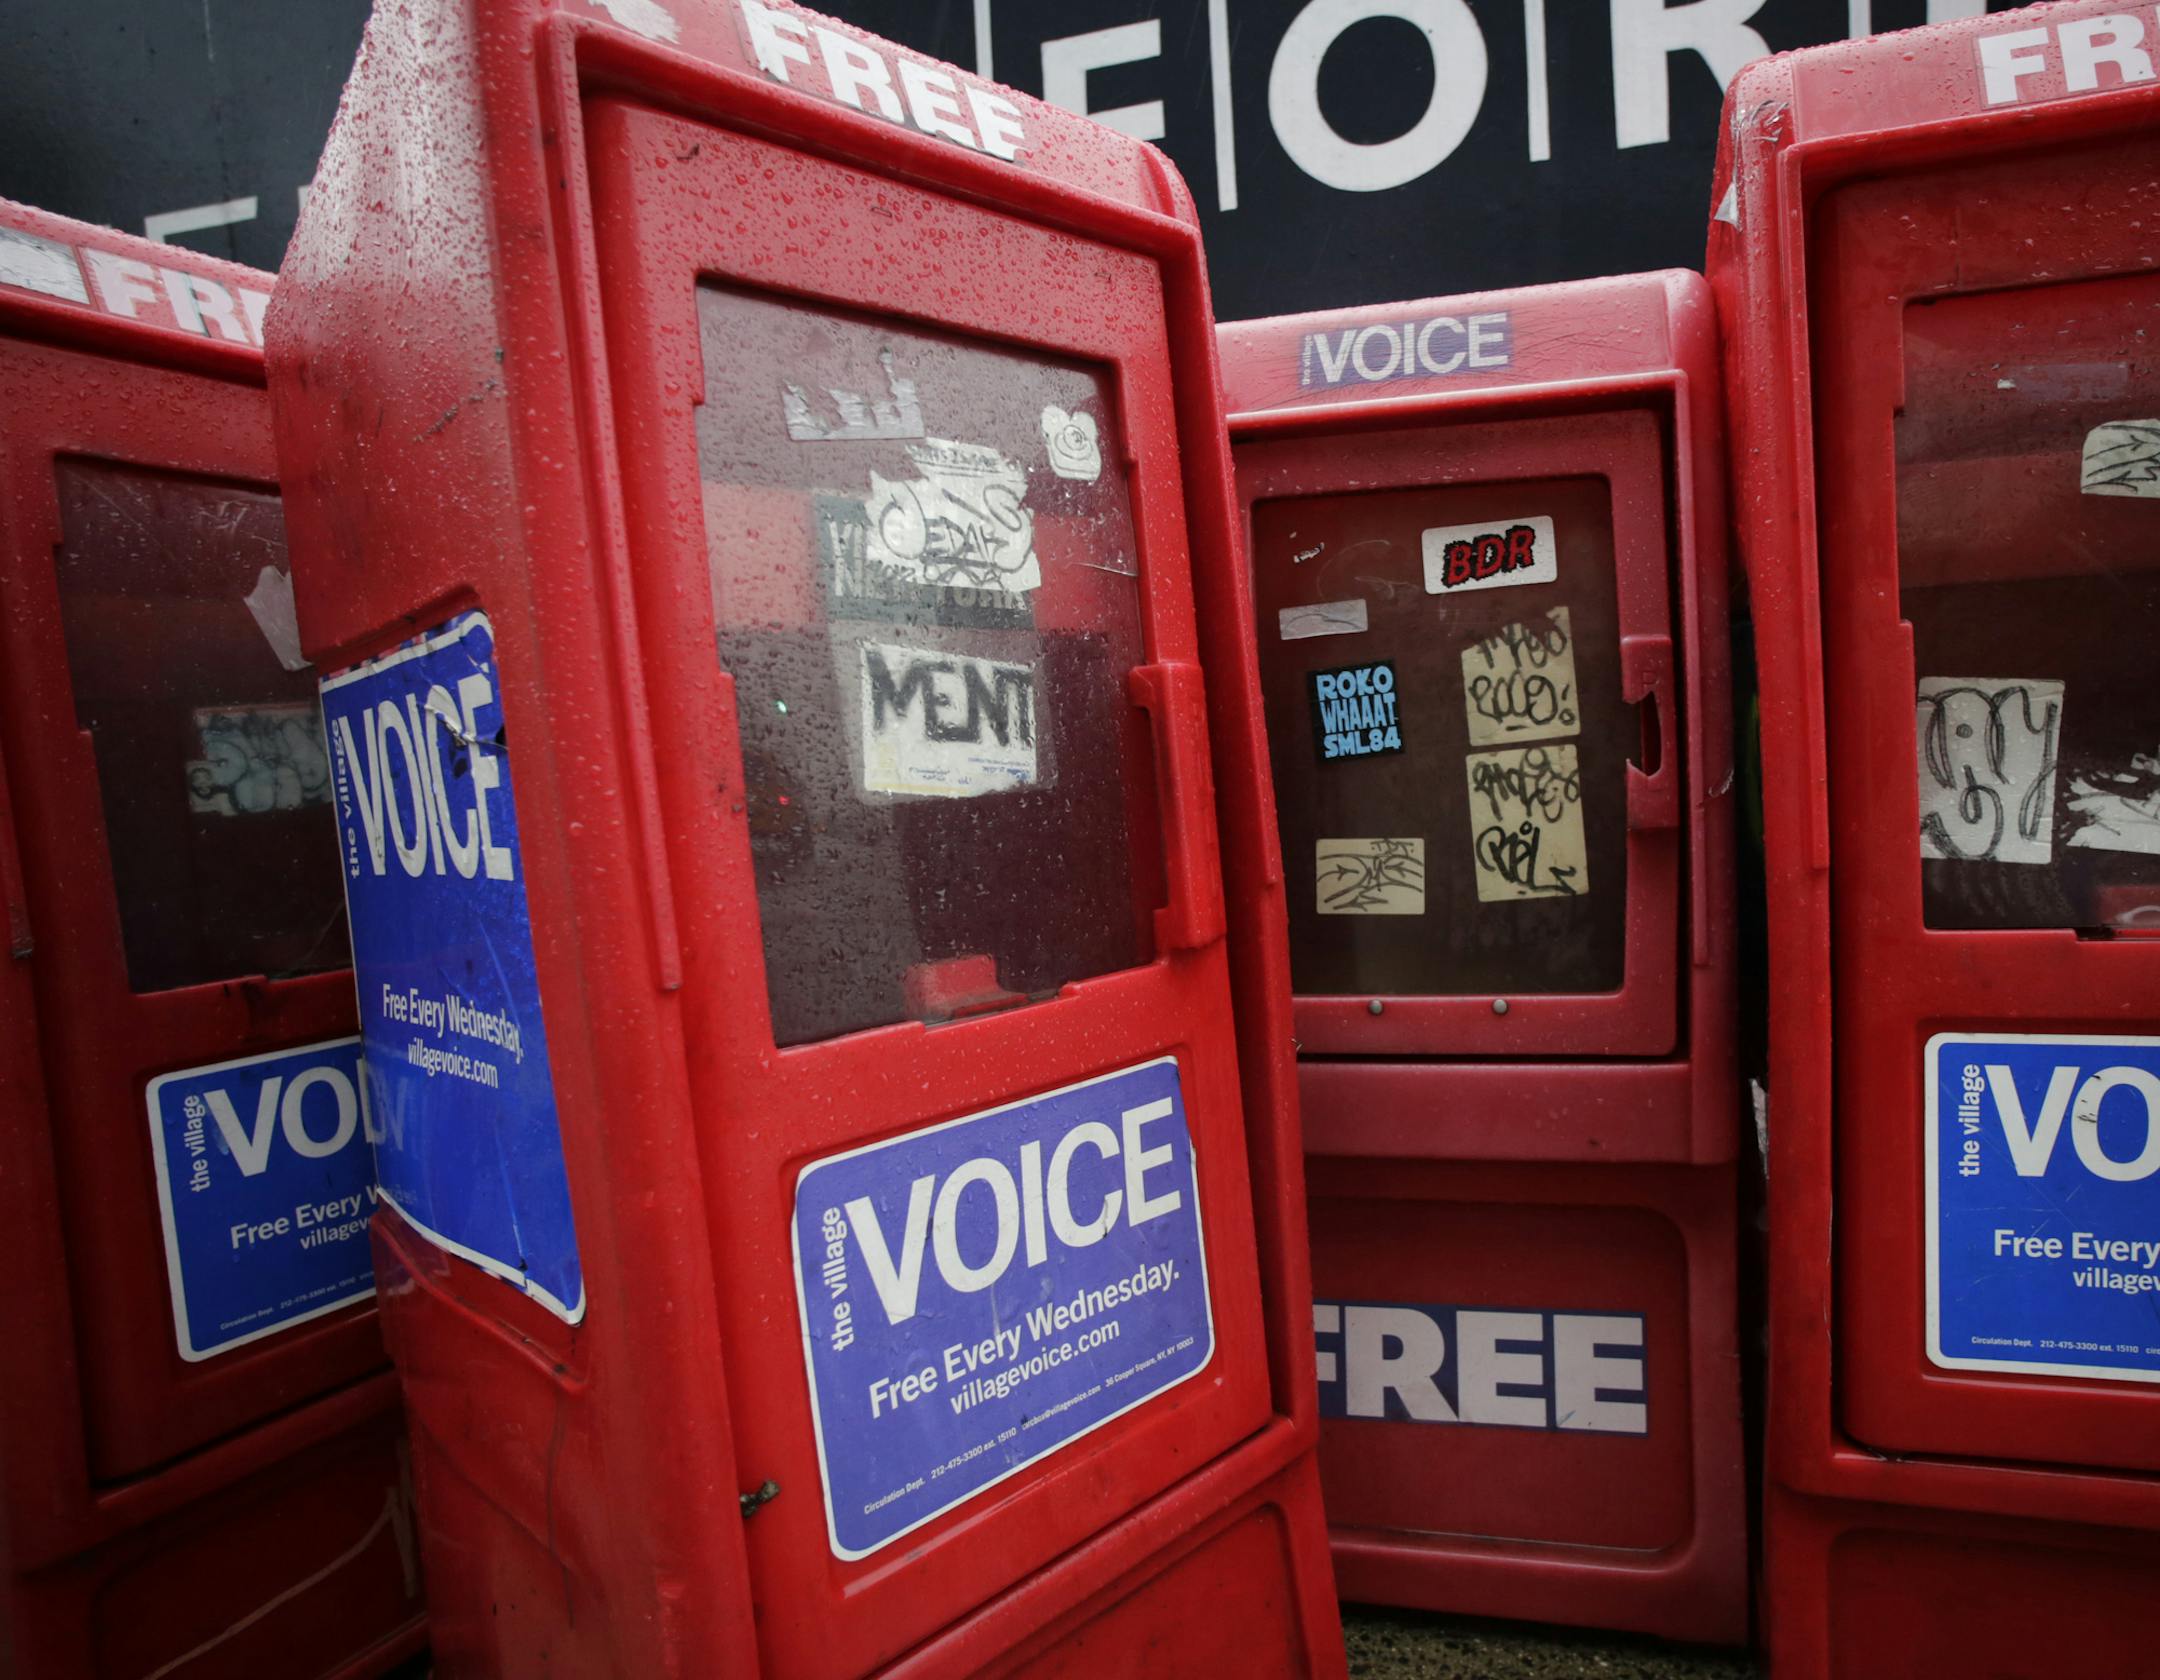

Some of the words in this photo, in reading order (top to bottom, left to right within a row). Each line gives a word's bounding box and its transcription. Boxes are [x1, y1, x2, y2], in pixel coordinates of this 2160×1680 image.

[742, 0, 1028, 162] FREE
[1979, 4, 2160, 105] FR
[1314, 312, 1508, 383] VOICE
[1441, 525, 1536, 588] BDR
[1316, 665, 1394, 701] ROKO
[1320, 692, 1396, 733] WHAAAT
[331, 719, 351, 819] village
[1324, 726, 1401, 758] SML84
[337, 673, 514, 881] VOICE
[348, 827, 360, 879] the
[383, 983, 407, 1022] Free
[410, 988, 445, 1038] Every
[445, 994, 524, 1064] Wednesday.
[408, 1037, 498, 1089] villagevoice.com
[183, 1094, 206, 1159] village
[1958, 1063, 1985, 1135] village
[191, 1160, 210, 1192] the
[1958, 1140, 1980, 1177] the
[230, 1216, 290, 1249] Free
[296, 1193, 362, 1230] Every
[844, 1096, 1182, 1326] VOICE
[822, 1207, 848, 1300] village
[1993, 1229, 2063, 1258] Free
[2071, 1232, 2160, 1269] Every
[831, 1301, 855, 1352] the
[869, 1366, 938, 1419] Free
[943, 1325, 1021, 1382] Every
[1026, 1259, 1180, 1342] Wednesday.
[1971, 1335, 2012, 1347] Circulation
[2013, 1337, 2033, 1348] Dept.
[2040, 1339, 2098, 1351] 212-475-3300
[2116, 1344, 2139, 1354] 15110
[950, 1320, 1120, 1415] villagevoice.com
[1313, 1304, 1647, 1434] REE
[864, 1487, 905, 1515] Circulation
[905, 1477, 925, 1493] Dept.
[931, 1444, 983, 1479] 212-475-3300
[997, 1427, 1017, 1443] 15110
